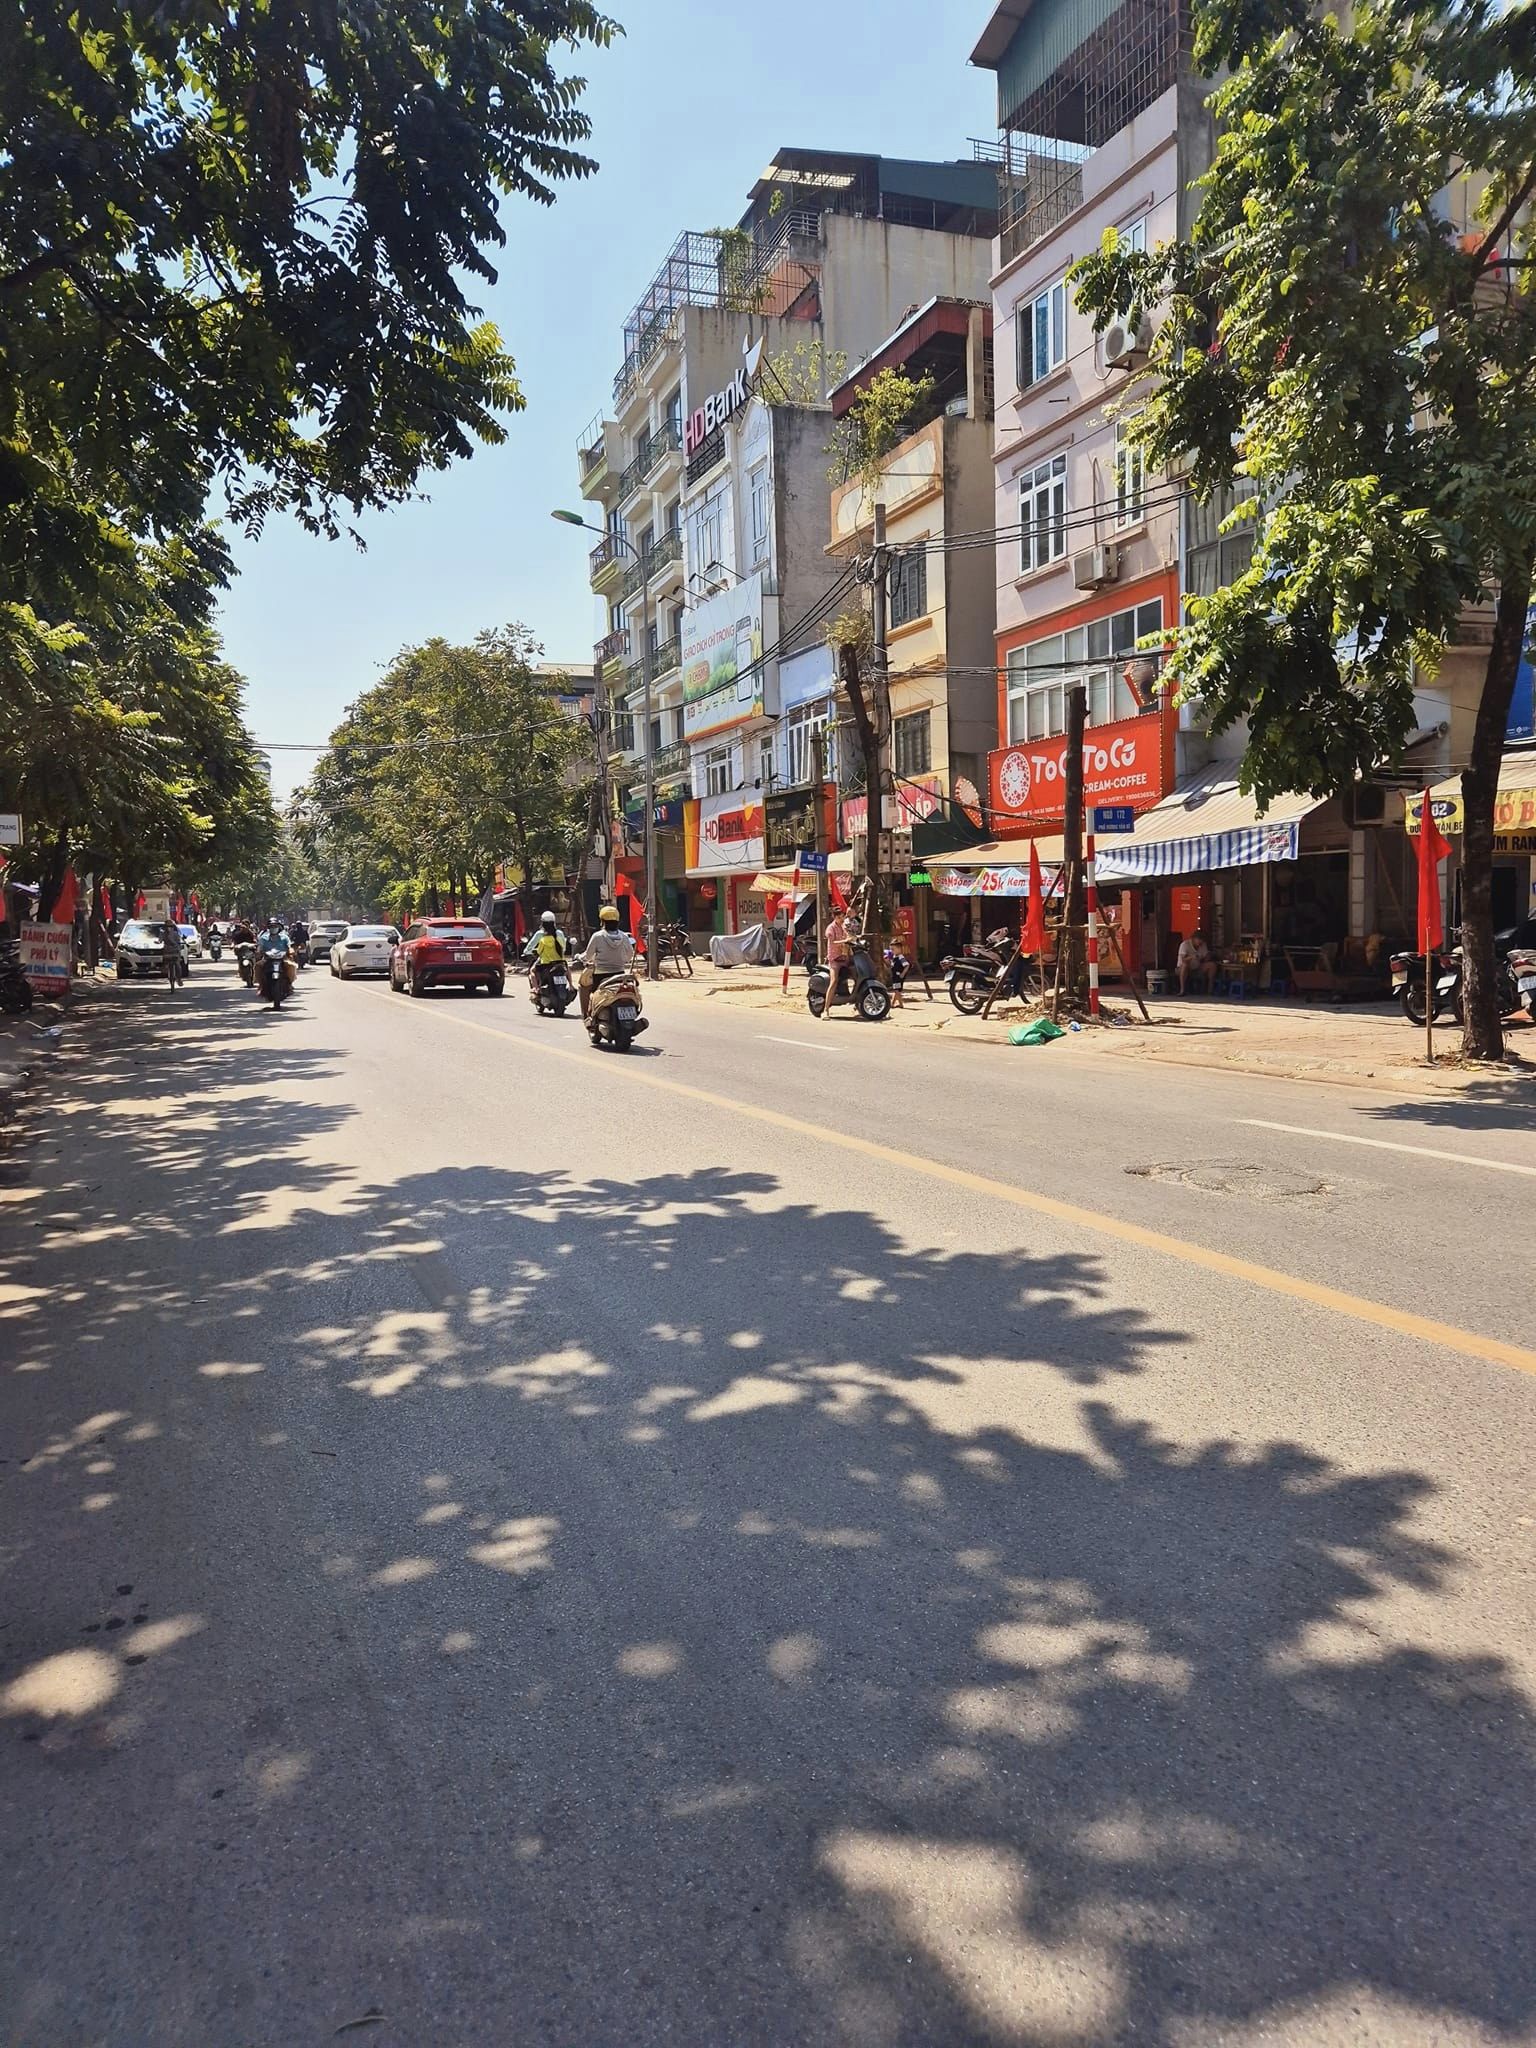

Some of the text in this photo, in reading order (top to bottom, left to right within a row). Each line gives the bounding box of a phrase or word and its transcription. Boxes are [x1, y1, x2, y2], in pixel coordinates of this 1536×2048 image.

[682, 368, 747, 456] HDBank
[705, 815, 743, 841] HDBank
[1007, 876, 1025, 887] Kem
[740, 900, 765, 914] HDBank
